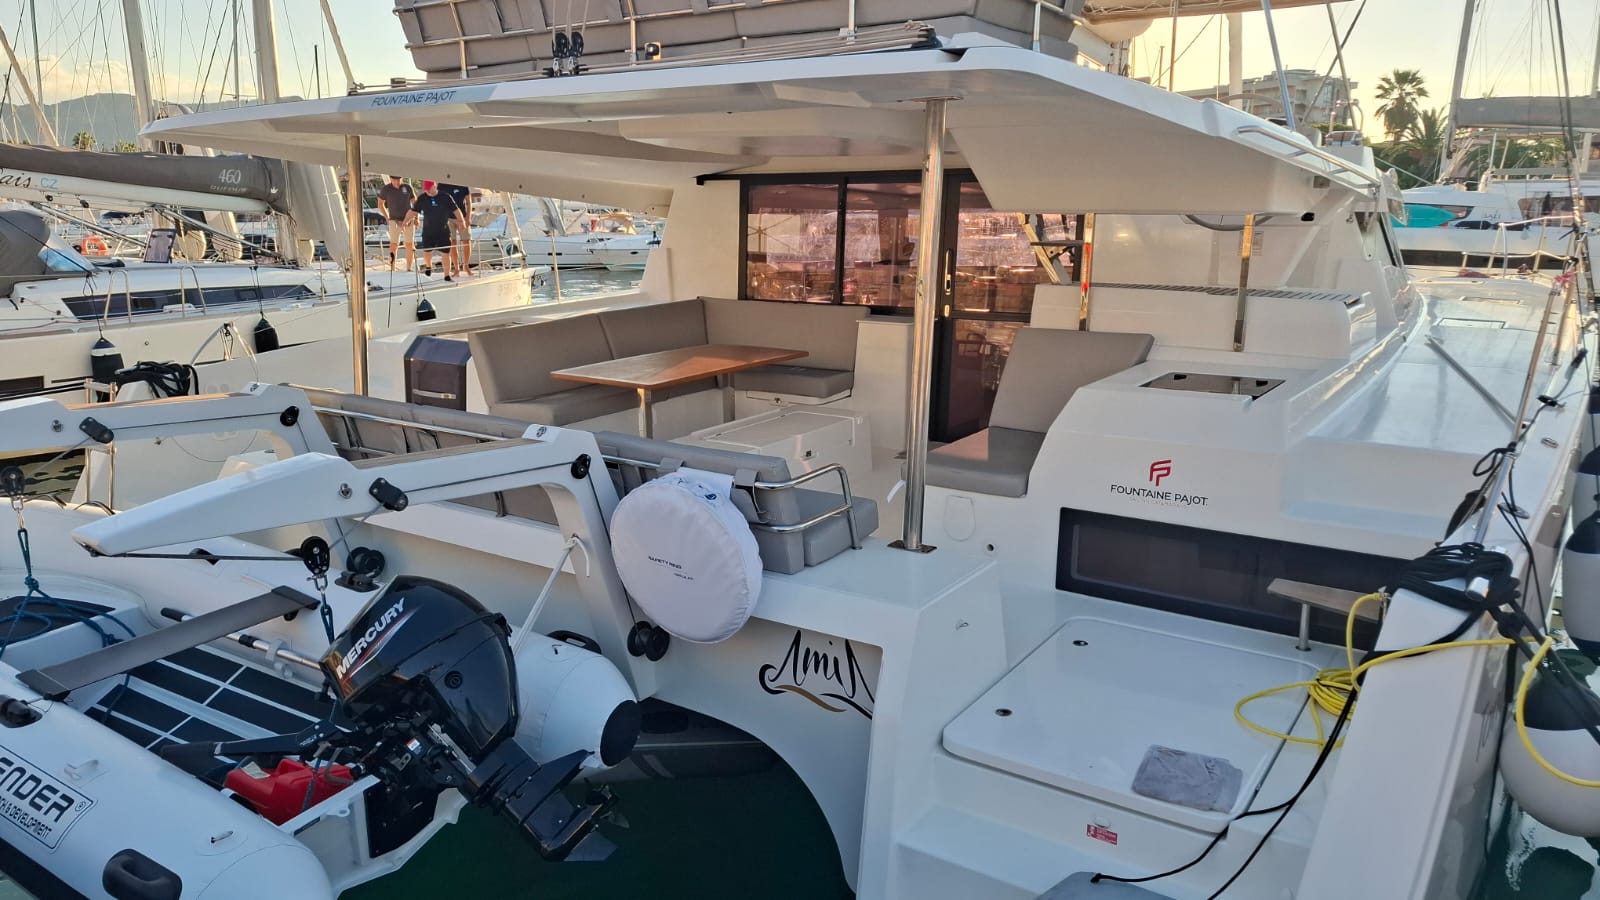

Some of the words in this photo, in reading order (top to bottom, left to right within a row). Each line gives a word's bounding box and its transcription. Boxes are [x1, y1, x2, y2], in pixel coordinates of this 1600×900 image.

[371, 92, 425, 107] FOUNTAINE
[425, 91, 456, 104] PAJOT
[218, 168, 242, 184] 460
[1110, 484, 1172, 501] FOUNTAINE
[1174, 493, 1208, 506] PAJOT
[335, 597, 405, 680] MERCURY
